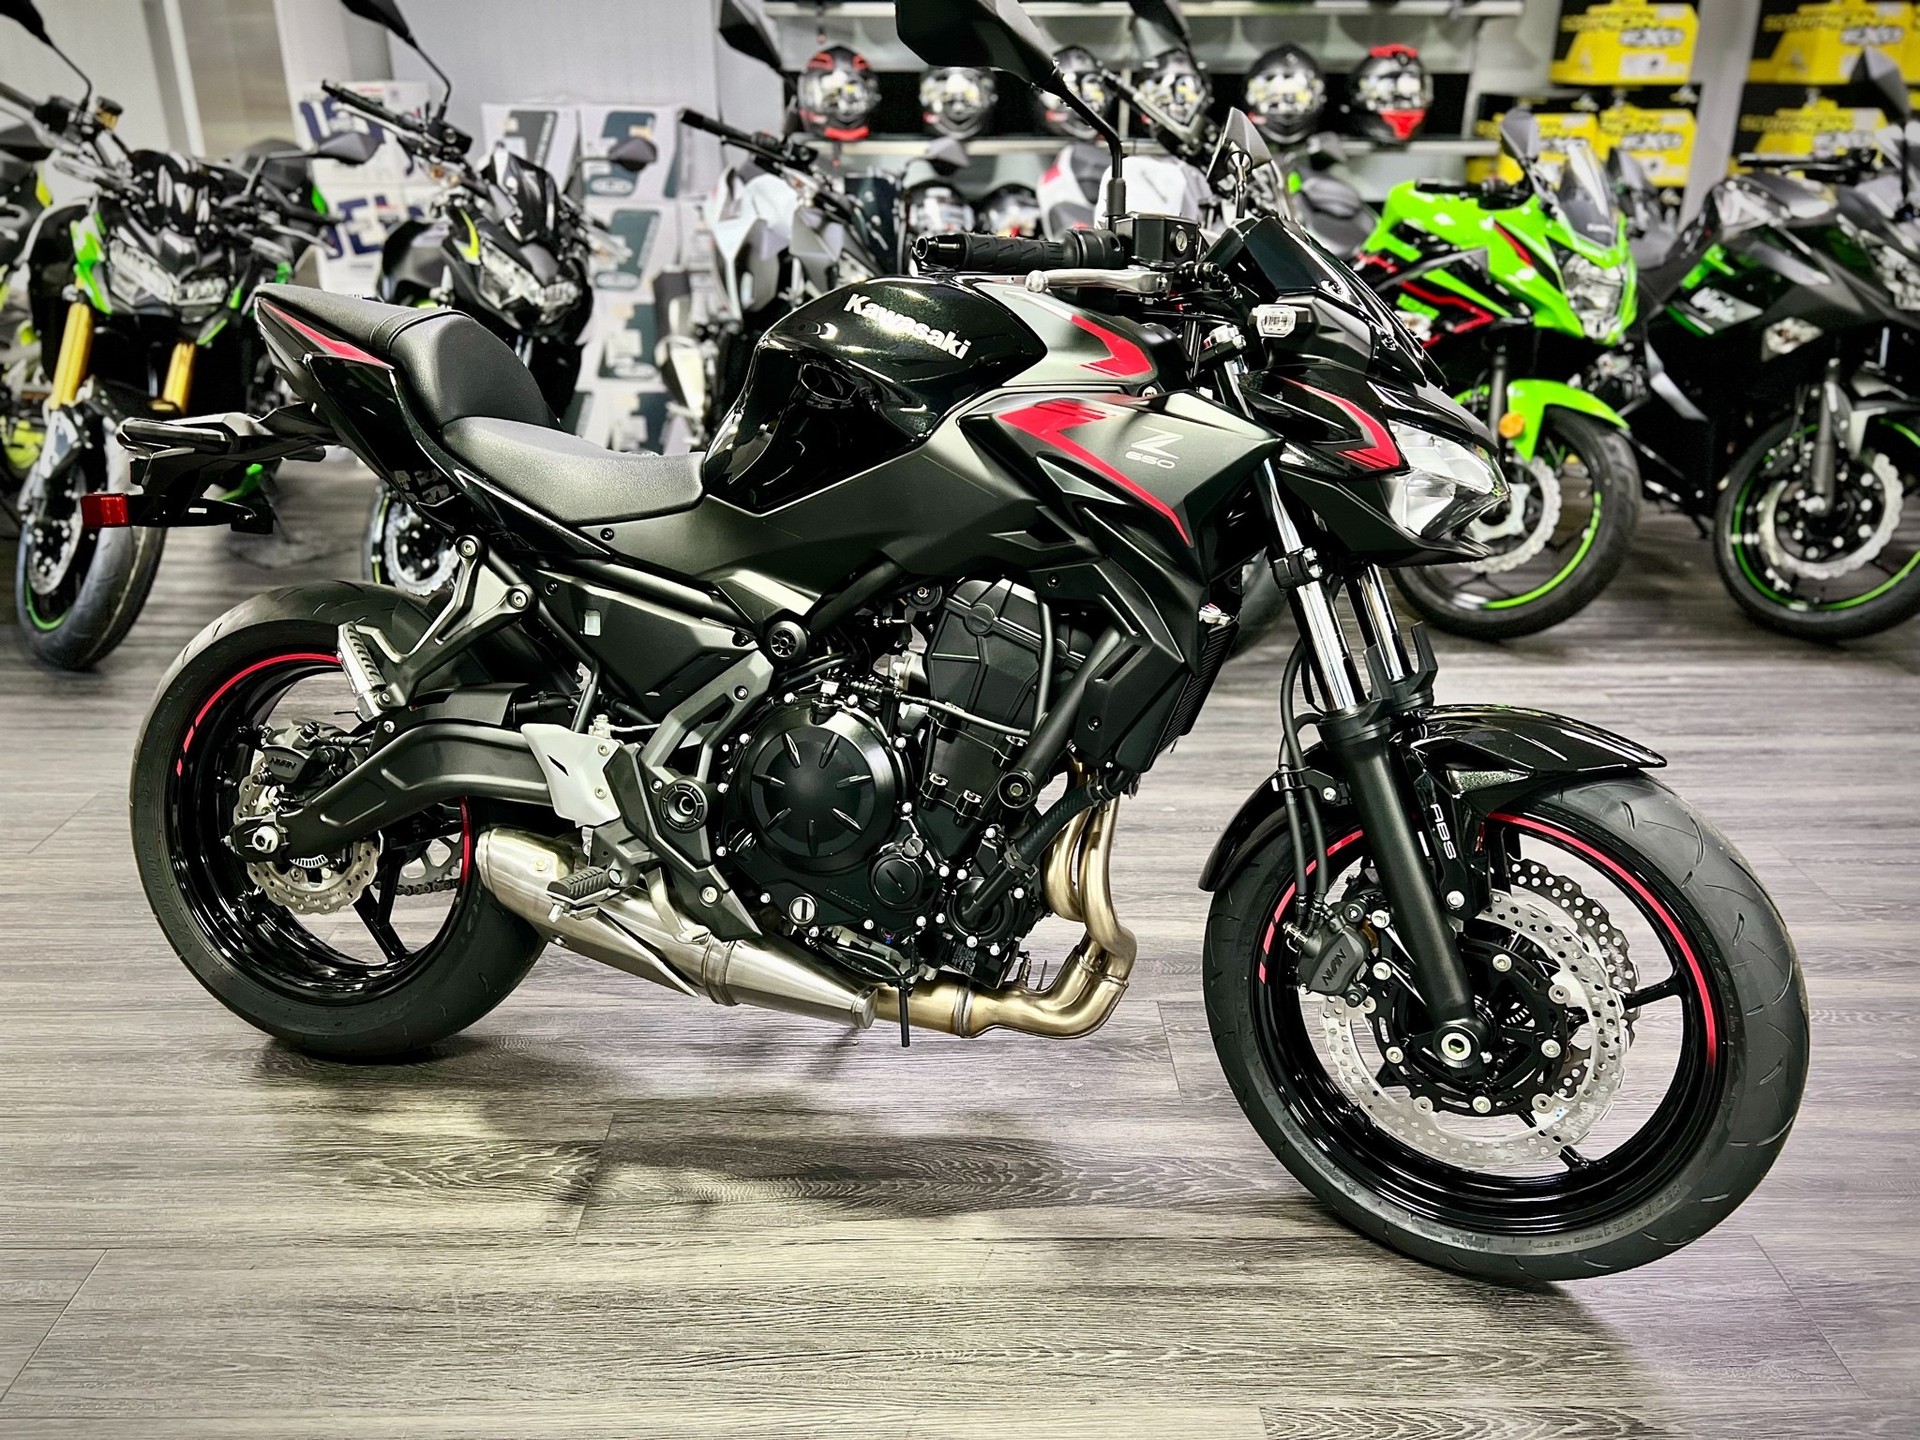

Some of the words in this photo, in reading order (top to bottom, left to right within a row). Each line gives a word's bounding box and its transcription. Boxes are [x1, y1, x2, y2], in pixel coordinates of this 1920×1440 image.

[843, 293, 972, 360] Kawasaki
[1125, 451, 1176, 470] 650
[1131, 425, 1184, 459] Z
[1430, 803, 1457, 860] ABS
